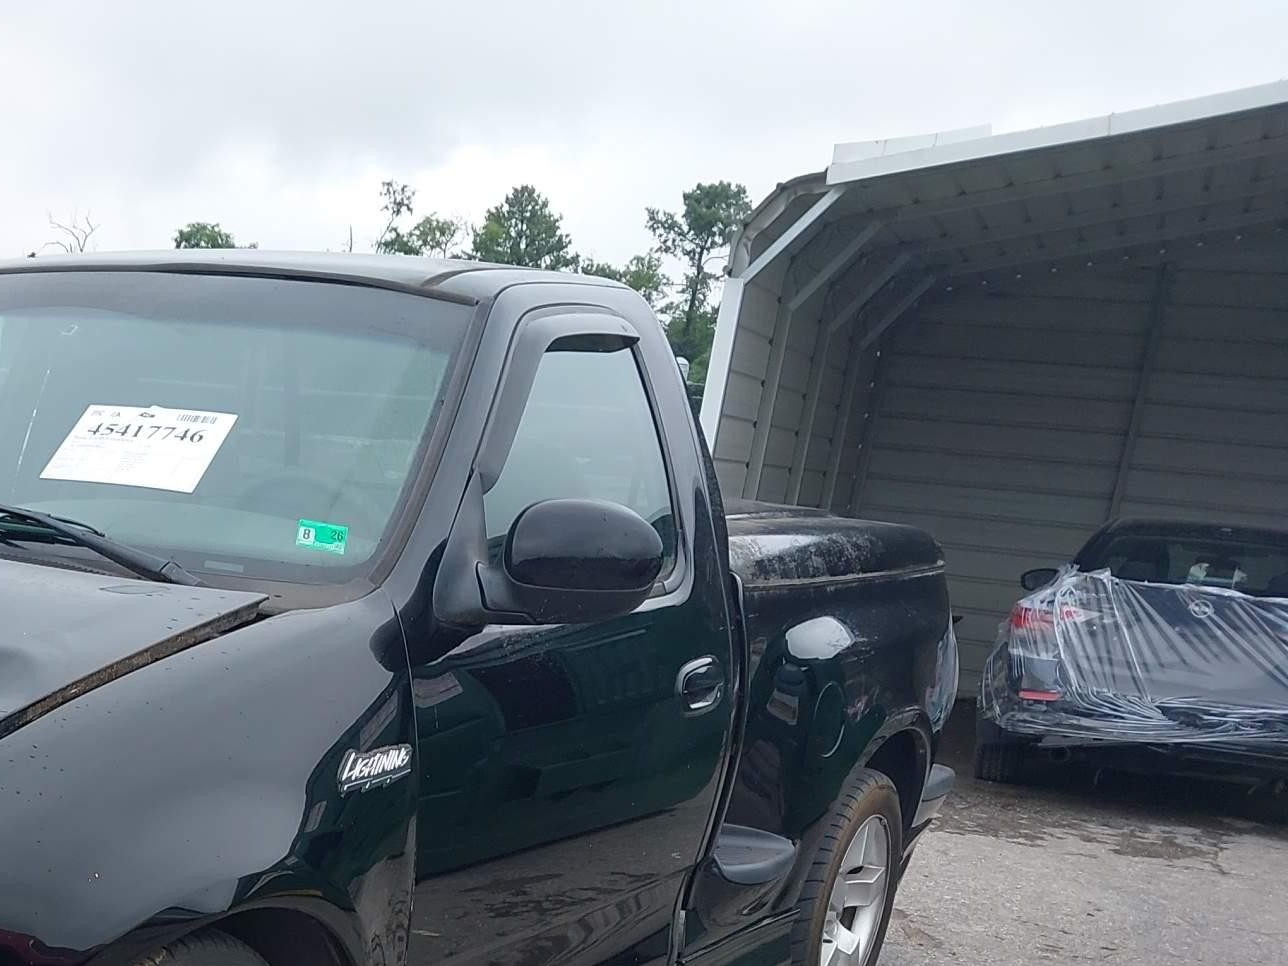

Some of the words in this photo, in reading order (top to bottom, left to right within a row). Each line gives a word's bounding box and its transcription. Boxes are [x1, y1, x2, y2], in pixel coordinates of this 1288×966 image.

[87, 422, 209, 444] 45417746
[303, 528, 311, 540] 8
[330, 530, 344, 542] 26
